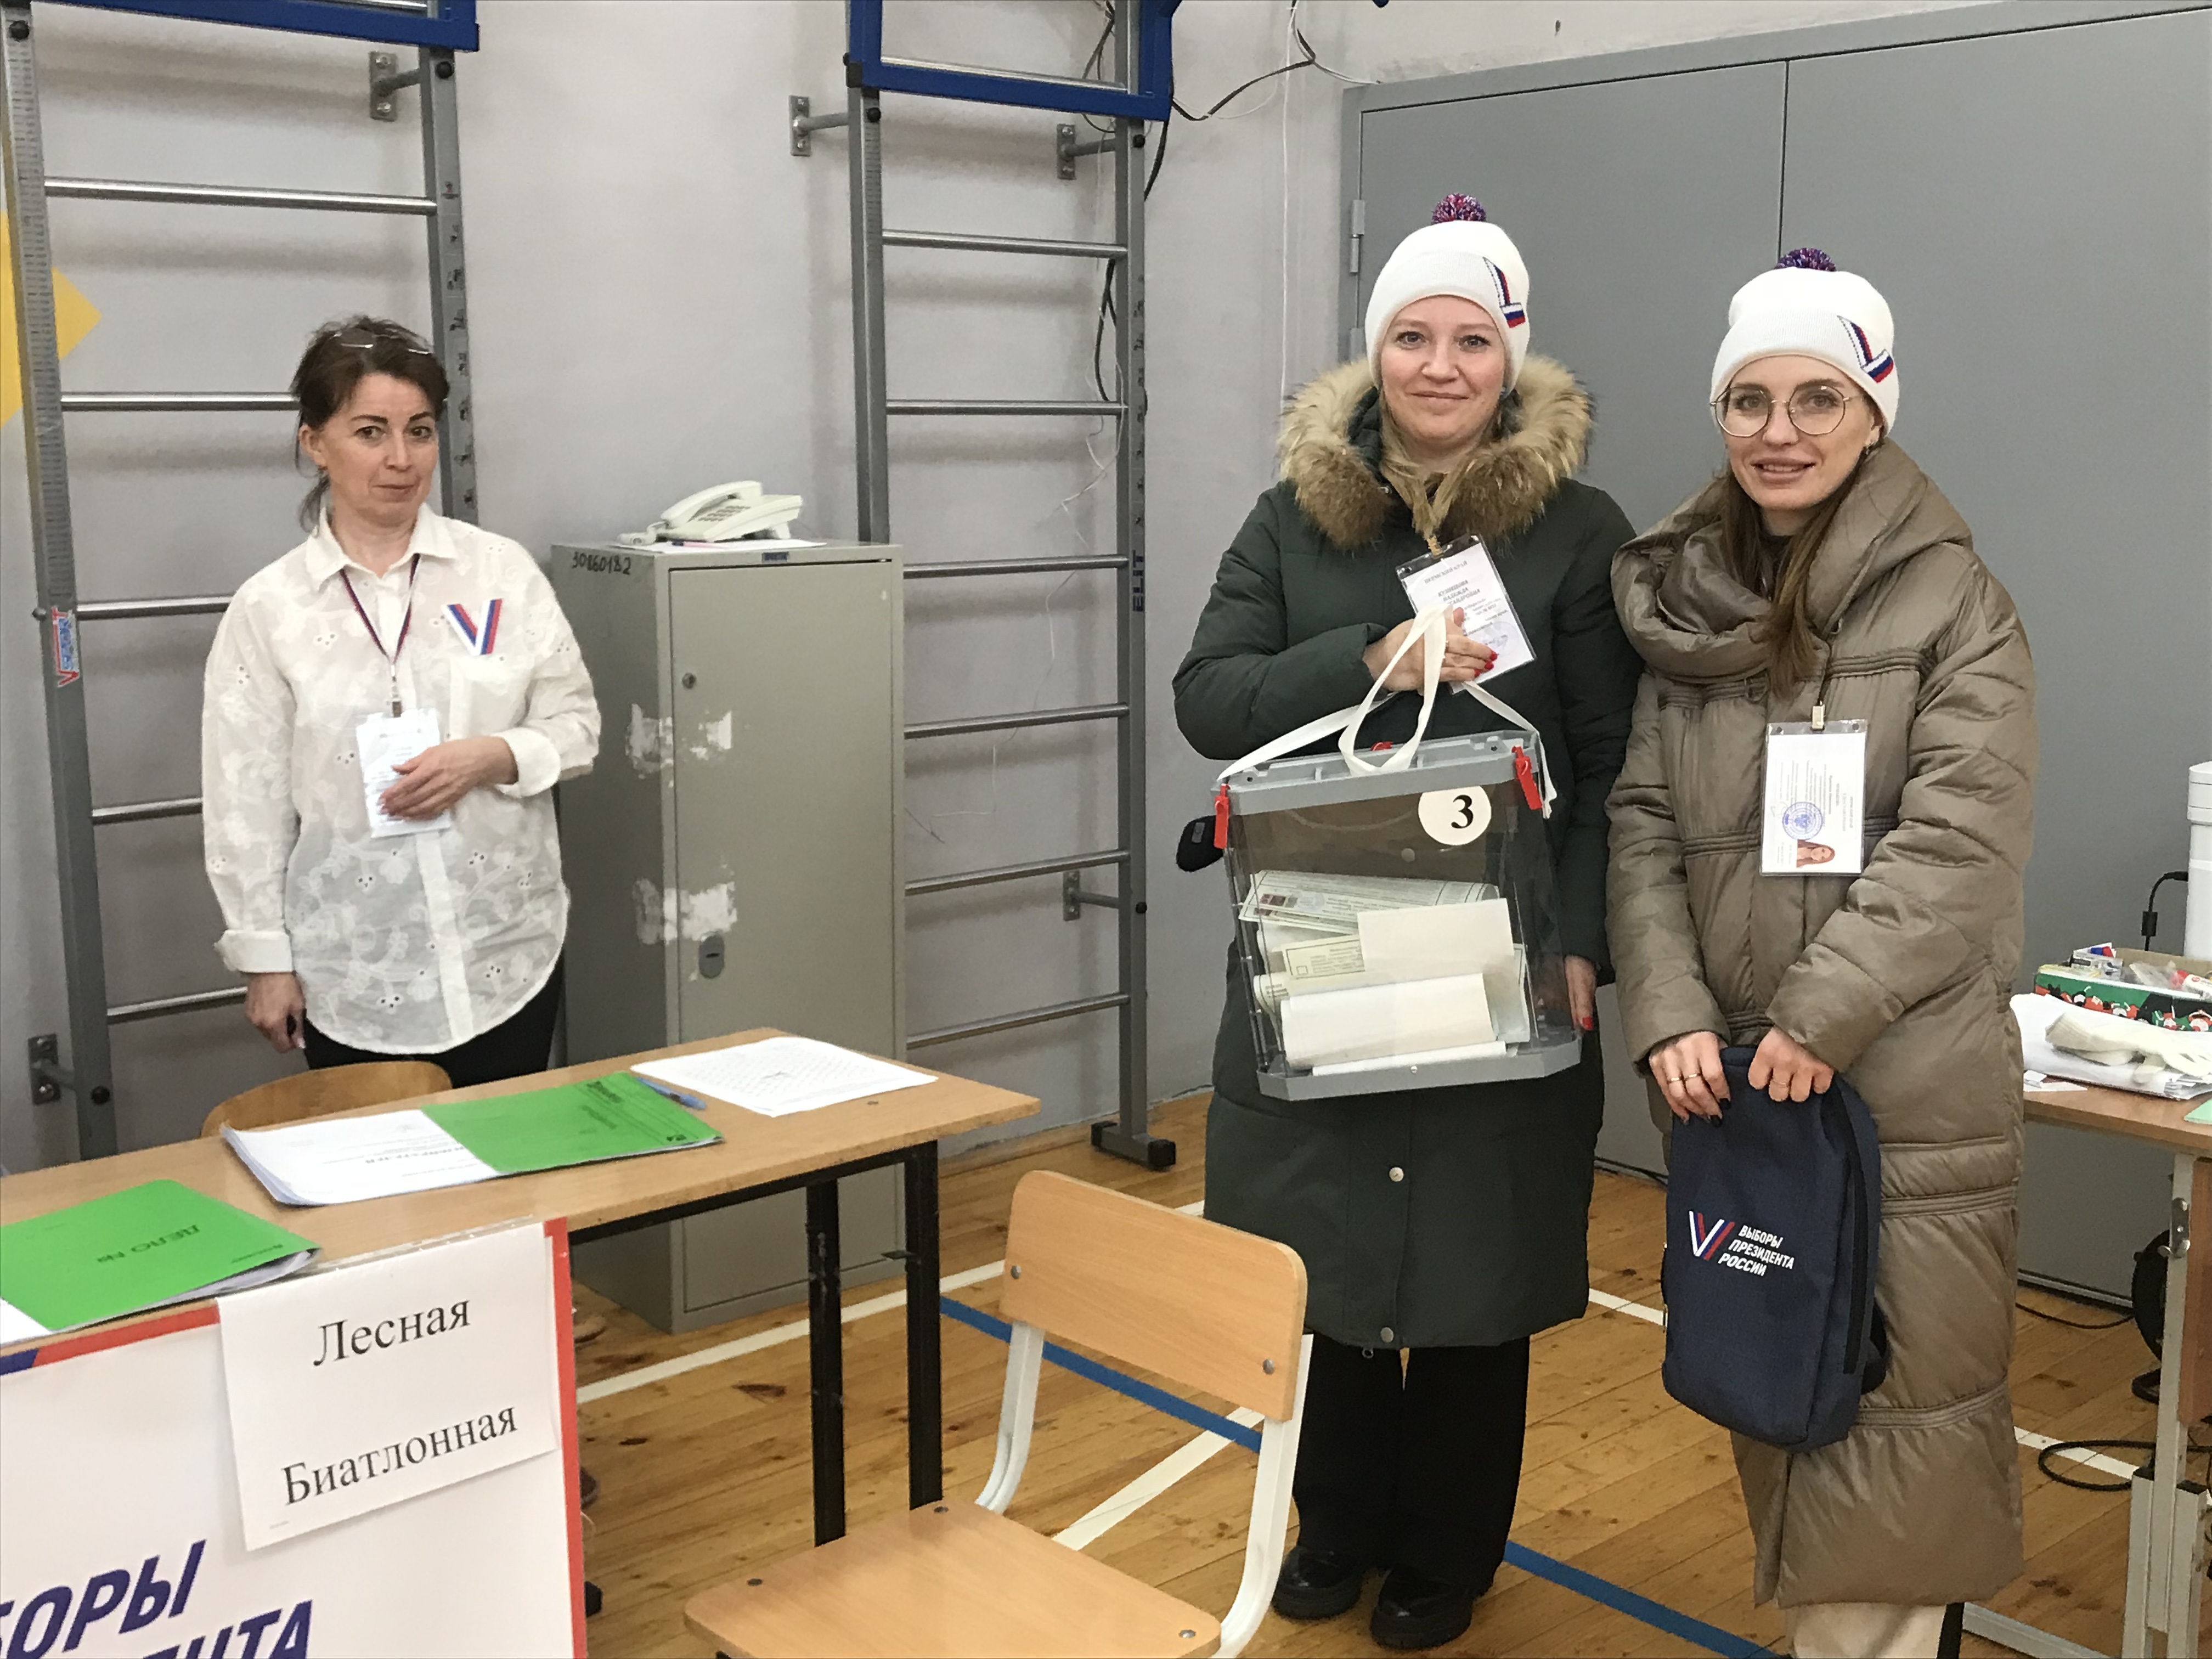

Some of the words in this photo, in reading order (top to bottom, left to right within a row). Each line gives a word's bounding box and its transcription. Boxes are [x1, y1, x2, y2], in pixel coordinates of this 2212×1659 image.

[1132, 549, 1145, 612] ELIT
[1451, 794, 1474, 829] 3
[131, 1224, 200, 1252] ДЕЛО
[1738, 1224, 1784, 1249] ВЫБОРЫ
[1718, 1252, 1767, 1277] РОССИИ
[1728, 1239, 1795, 1269] ПРЕЗИДЕНТА
[313, 1301, 471, 1366] Лесная
[282, 1407, 518, 1505] Биатлонная
